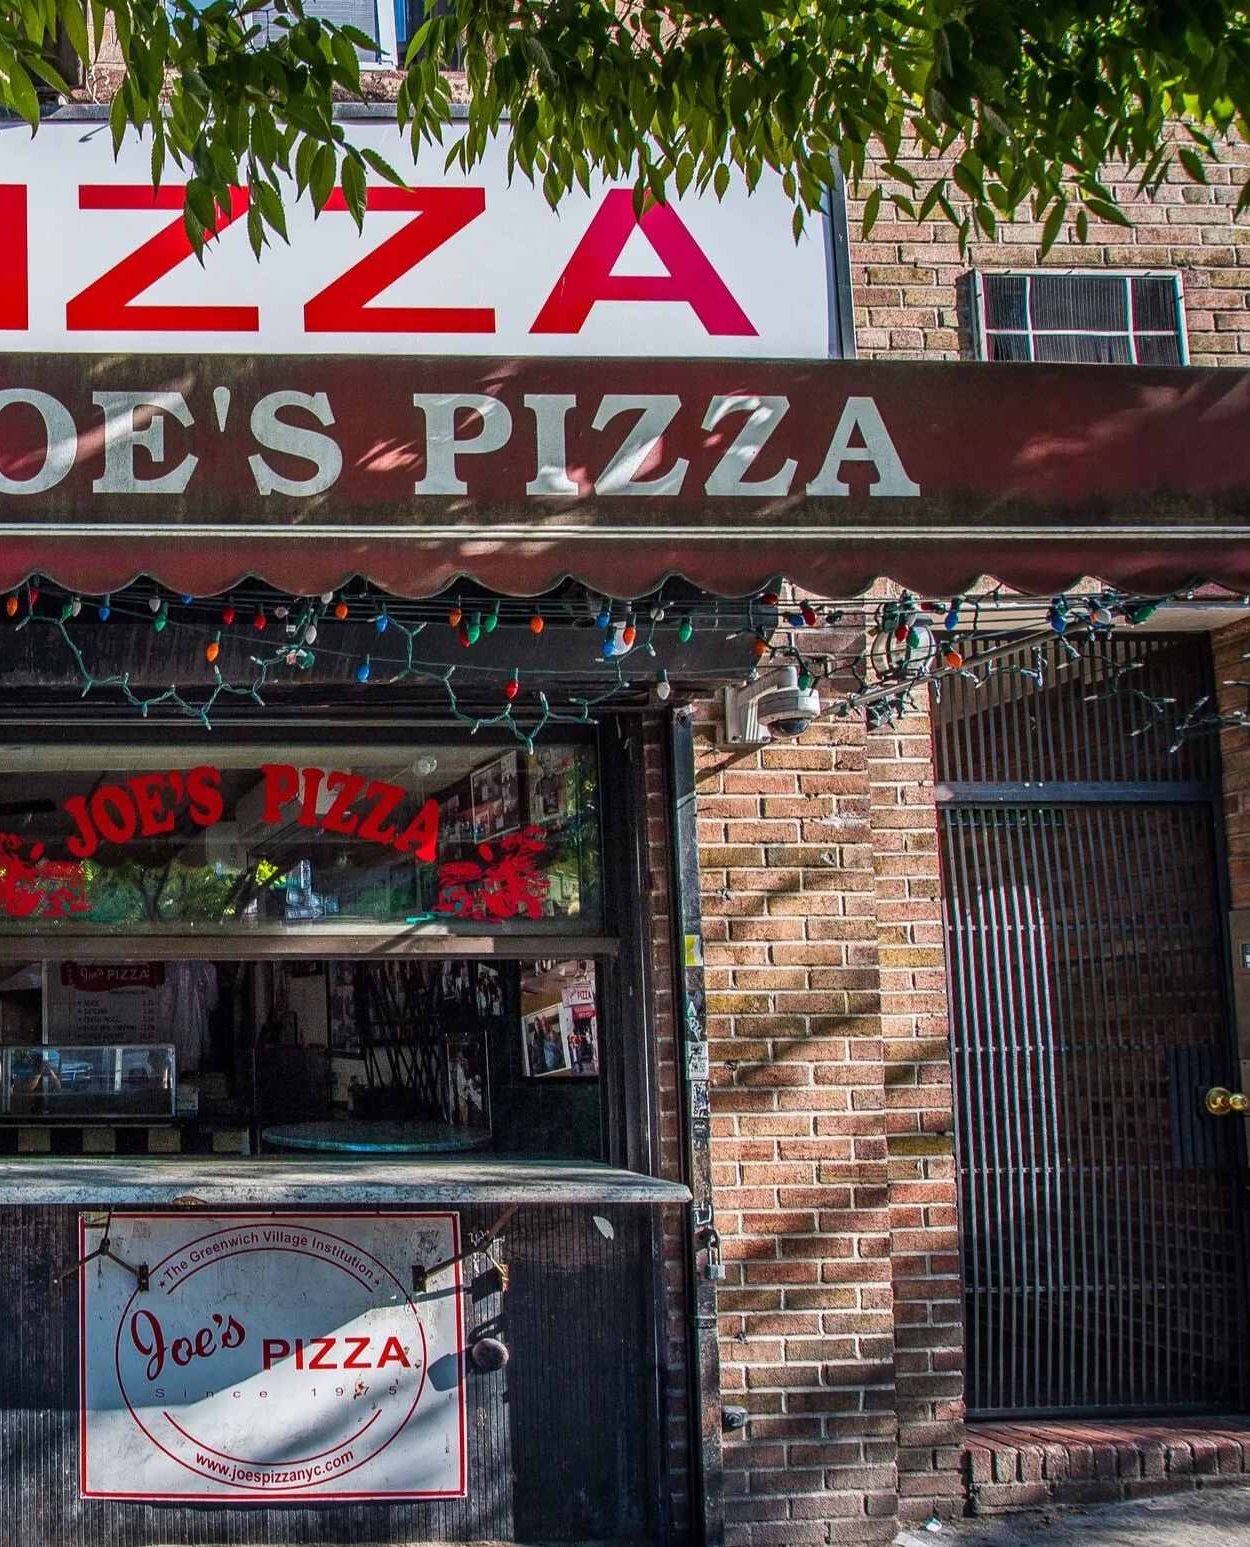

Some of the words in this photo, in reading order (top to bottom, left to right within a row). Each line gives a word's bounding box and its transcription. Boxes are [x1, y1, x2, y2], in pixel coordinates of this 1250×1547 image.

[412, 392, 921, 498] PIZZA
[62, 765, 224, 859] JOE'S
[260, 763, 441, 863] PIZZA
[106, 968, 149, 981] PIZZA
[163, 1259, 189, 1282] The
[189, 1232, 259, 1264] Greenwich
[262, 1230, 308, 1247] Village
[311, 1235, 375, 1280] Institution
[129, 1308, 246, 1382] Joe's
[262, 1336, 411, 1371] PIZZA
[154, 1386, 269, 1399] Since
[310, 1385, 398, 1398] 1975
[195, 1450, 355, 1486] www.joespizzanyc.com
